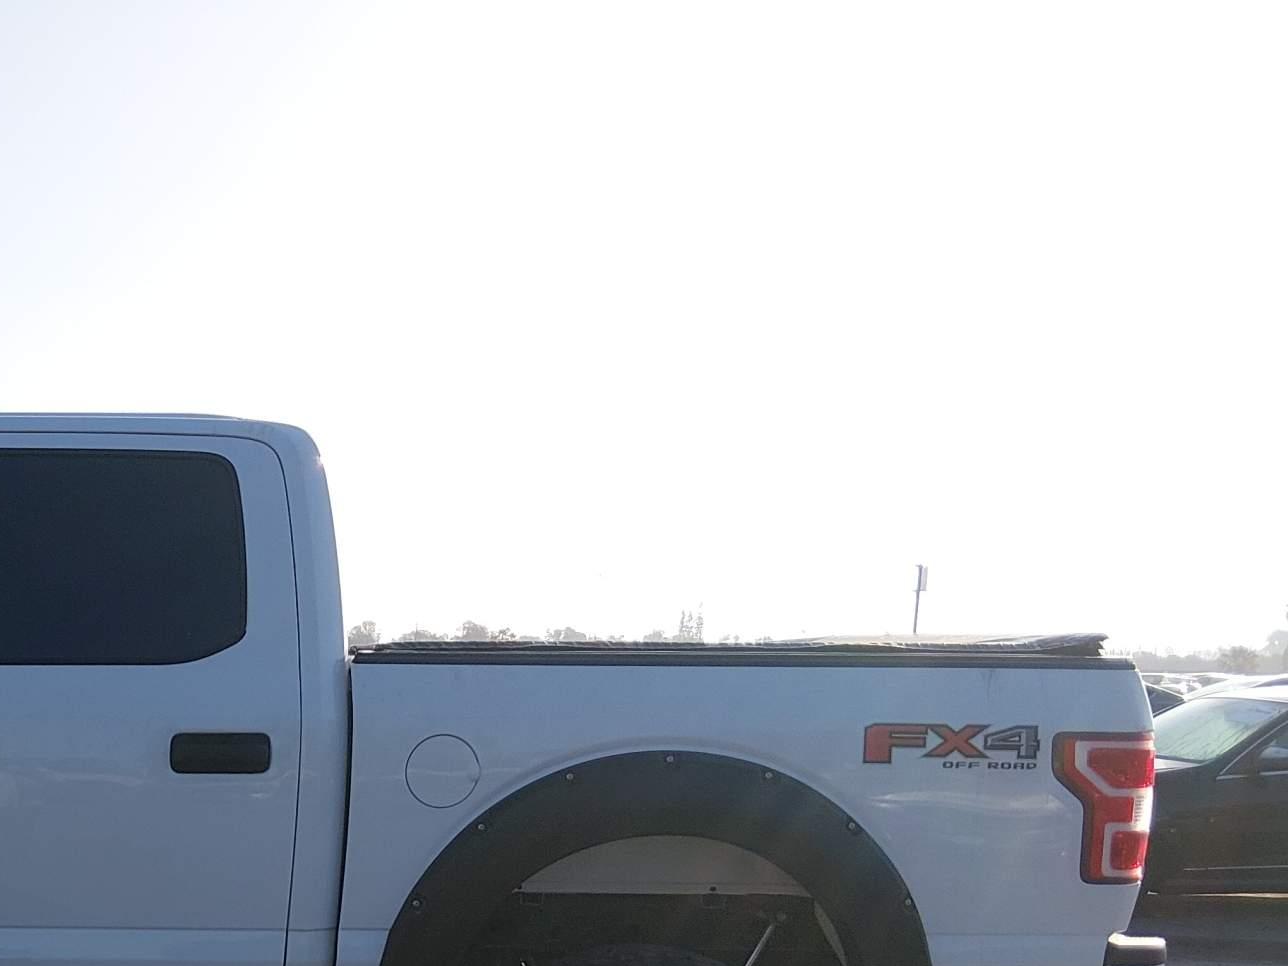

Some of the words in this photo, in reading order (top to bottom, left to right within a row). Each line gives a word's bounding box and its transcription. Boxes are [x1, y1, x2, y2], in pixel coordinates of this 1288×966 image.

[862, 722, 1041, 764] FX4
[942, 761, 980, 770] OFF
[987, 761, 1037, 770] ROAD
